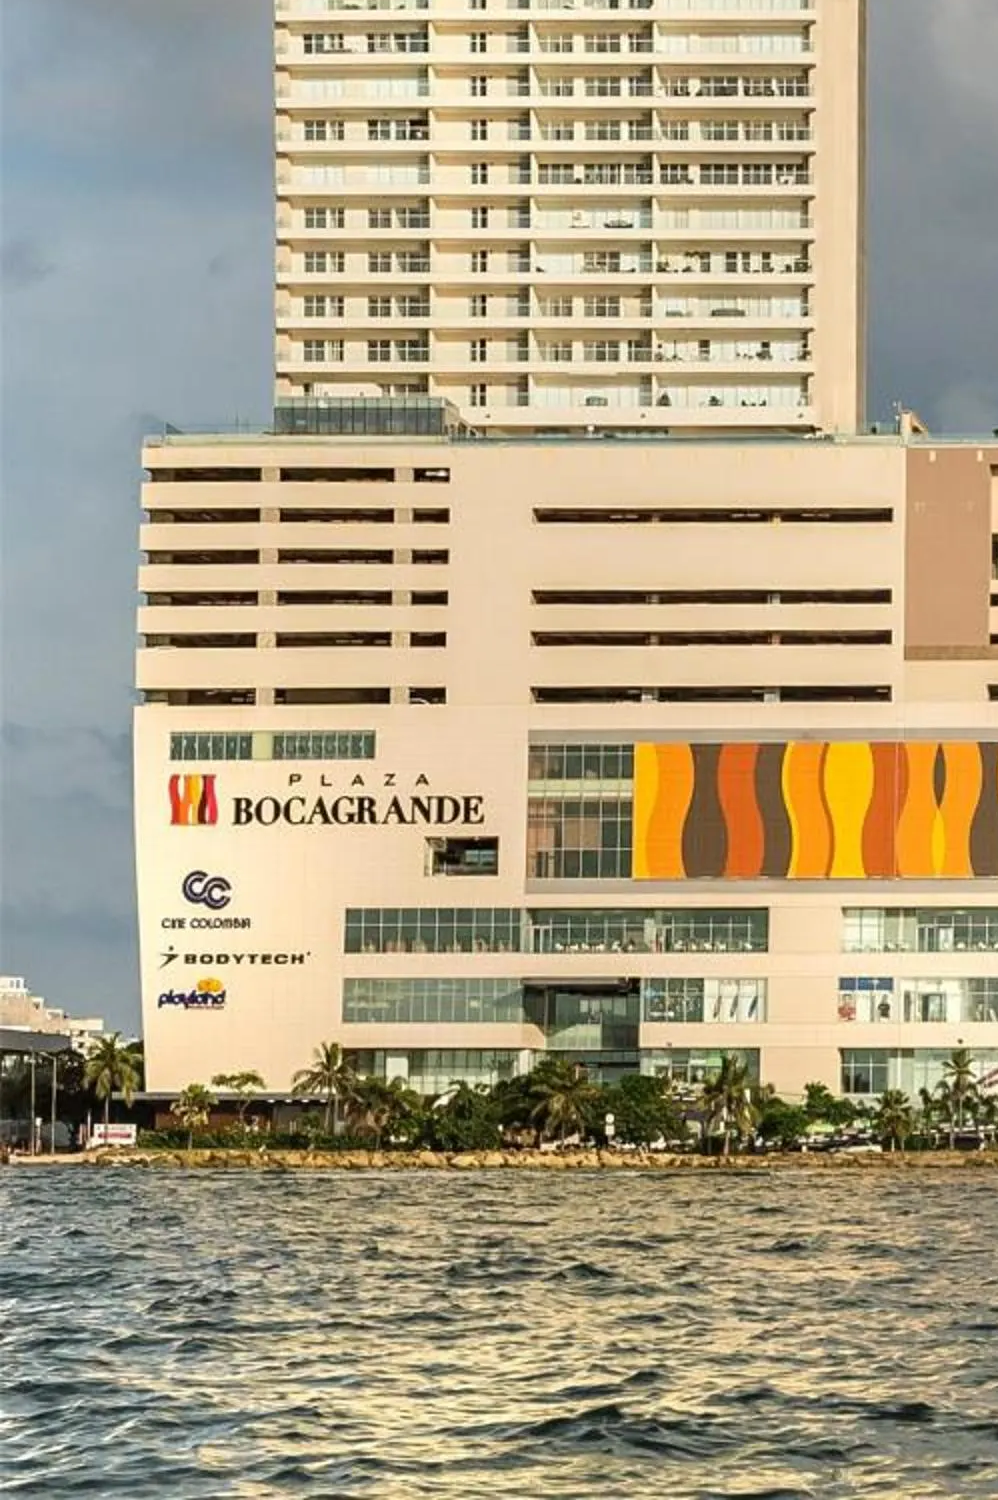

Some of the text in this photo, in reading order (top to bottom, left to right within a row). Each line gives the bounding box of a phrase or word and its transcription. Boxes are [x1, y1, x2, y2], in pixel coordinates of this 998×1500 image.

[289, 773, 429, 787] PLAZA
[232, 796, 485, 825] BOCAGRANDE
[184, 953, 305, 965] BODYTECH
